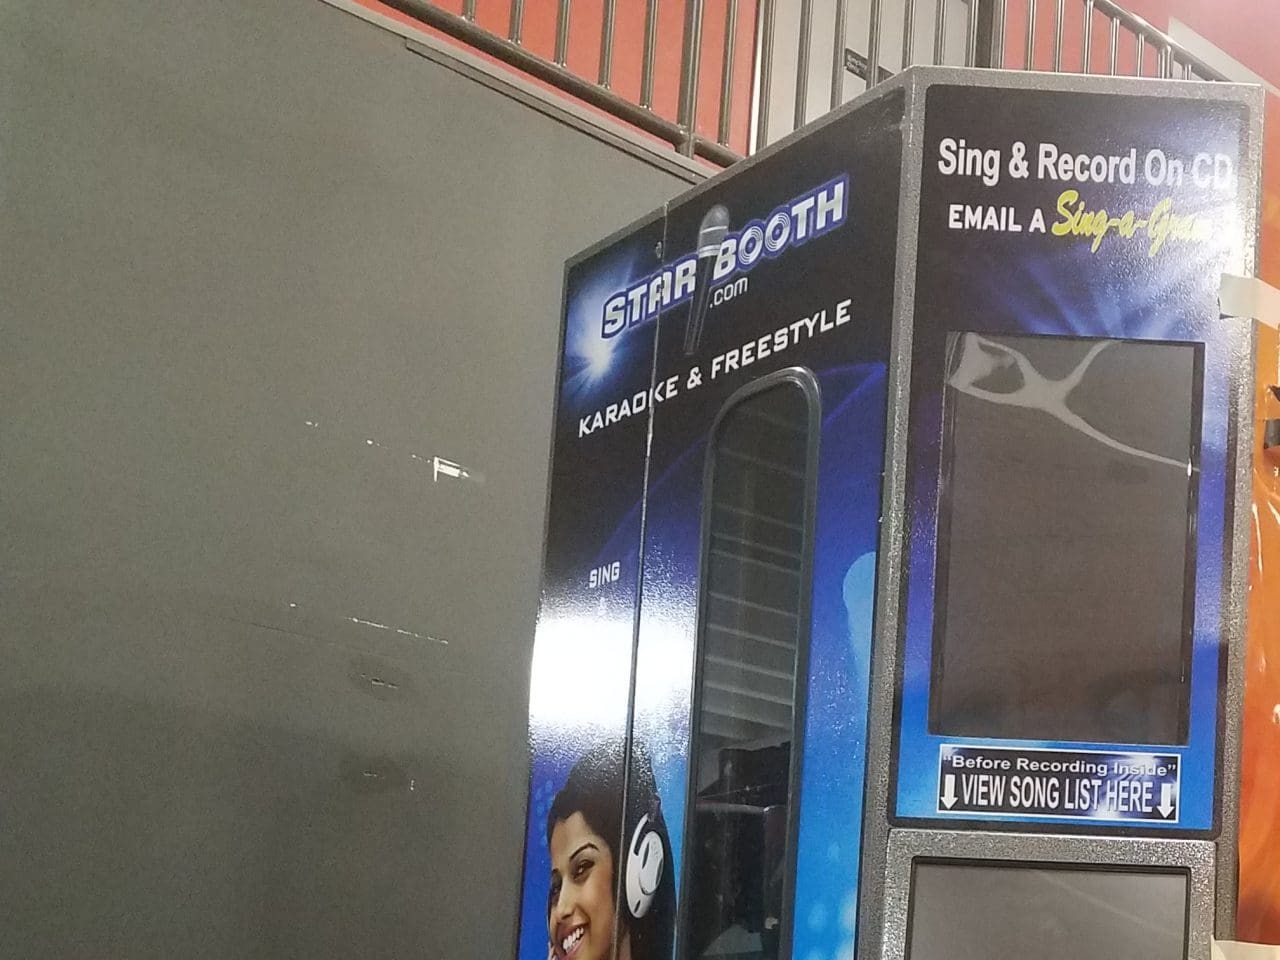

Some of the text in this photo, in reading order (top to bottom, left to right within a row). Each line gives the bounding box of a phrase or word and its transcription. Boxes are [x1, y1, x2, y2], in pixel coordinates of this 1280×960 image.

[938, 138, 1233, 189] Sing & Record On CD
[949, 204, 1022, 232] EMAIL
[1029, 208, 1046, 233] A
[603, 181, 846, 336] STAR BOOTH
[709, 278, 748, 308] .com
[578, 299, 852, 438] KARAOKE & FREESTYLE
[589, 561, 620, 588] SING
[1017, 758, 1107, 776] Recording
[962, 774, 1152, 812] VIEW SONG LIST HERE
